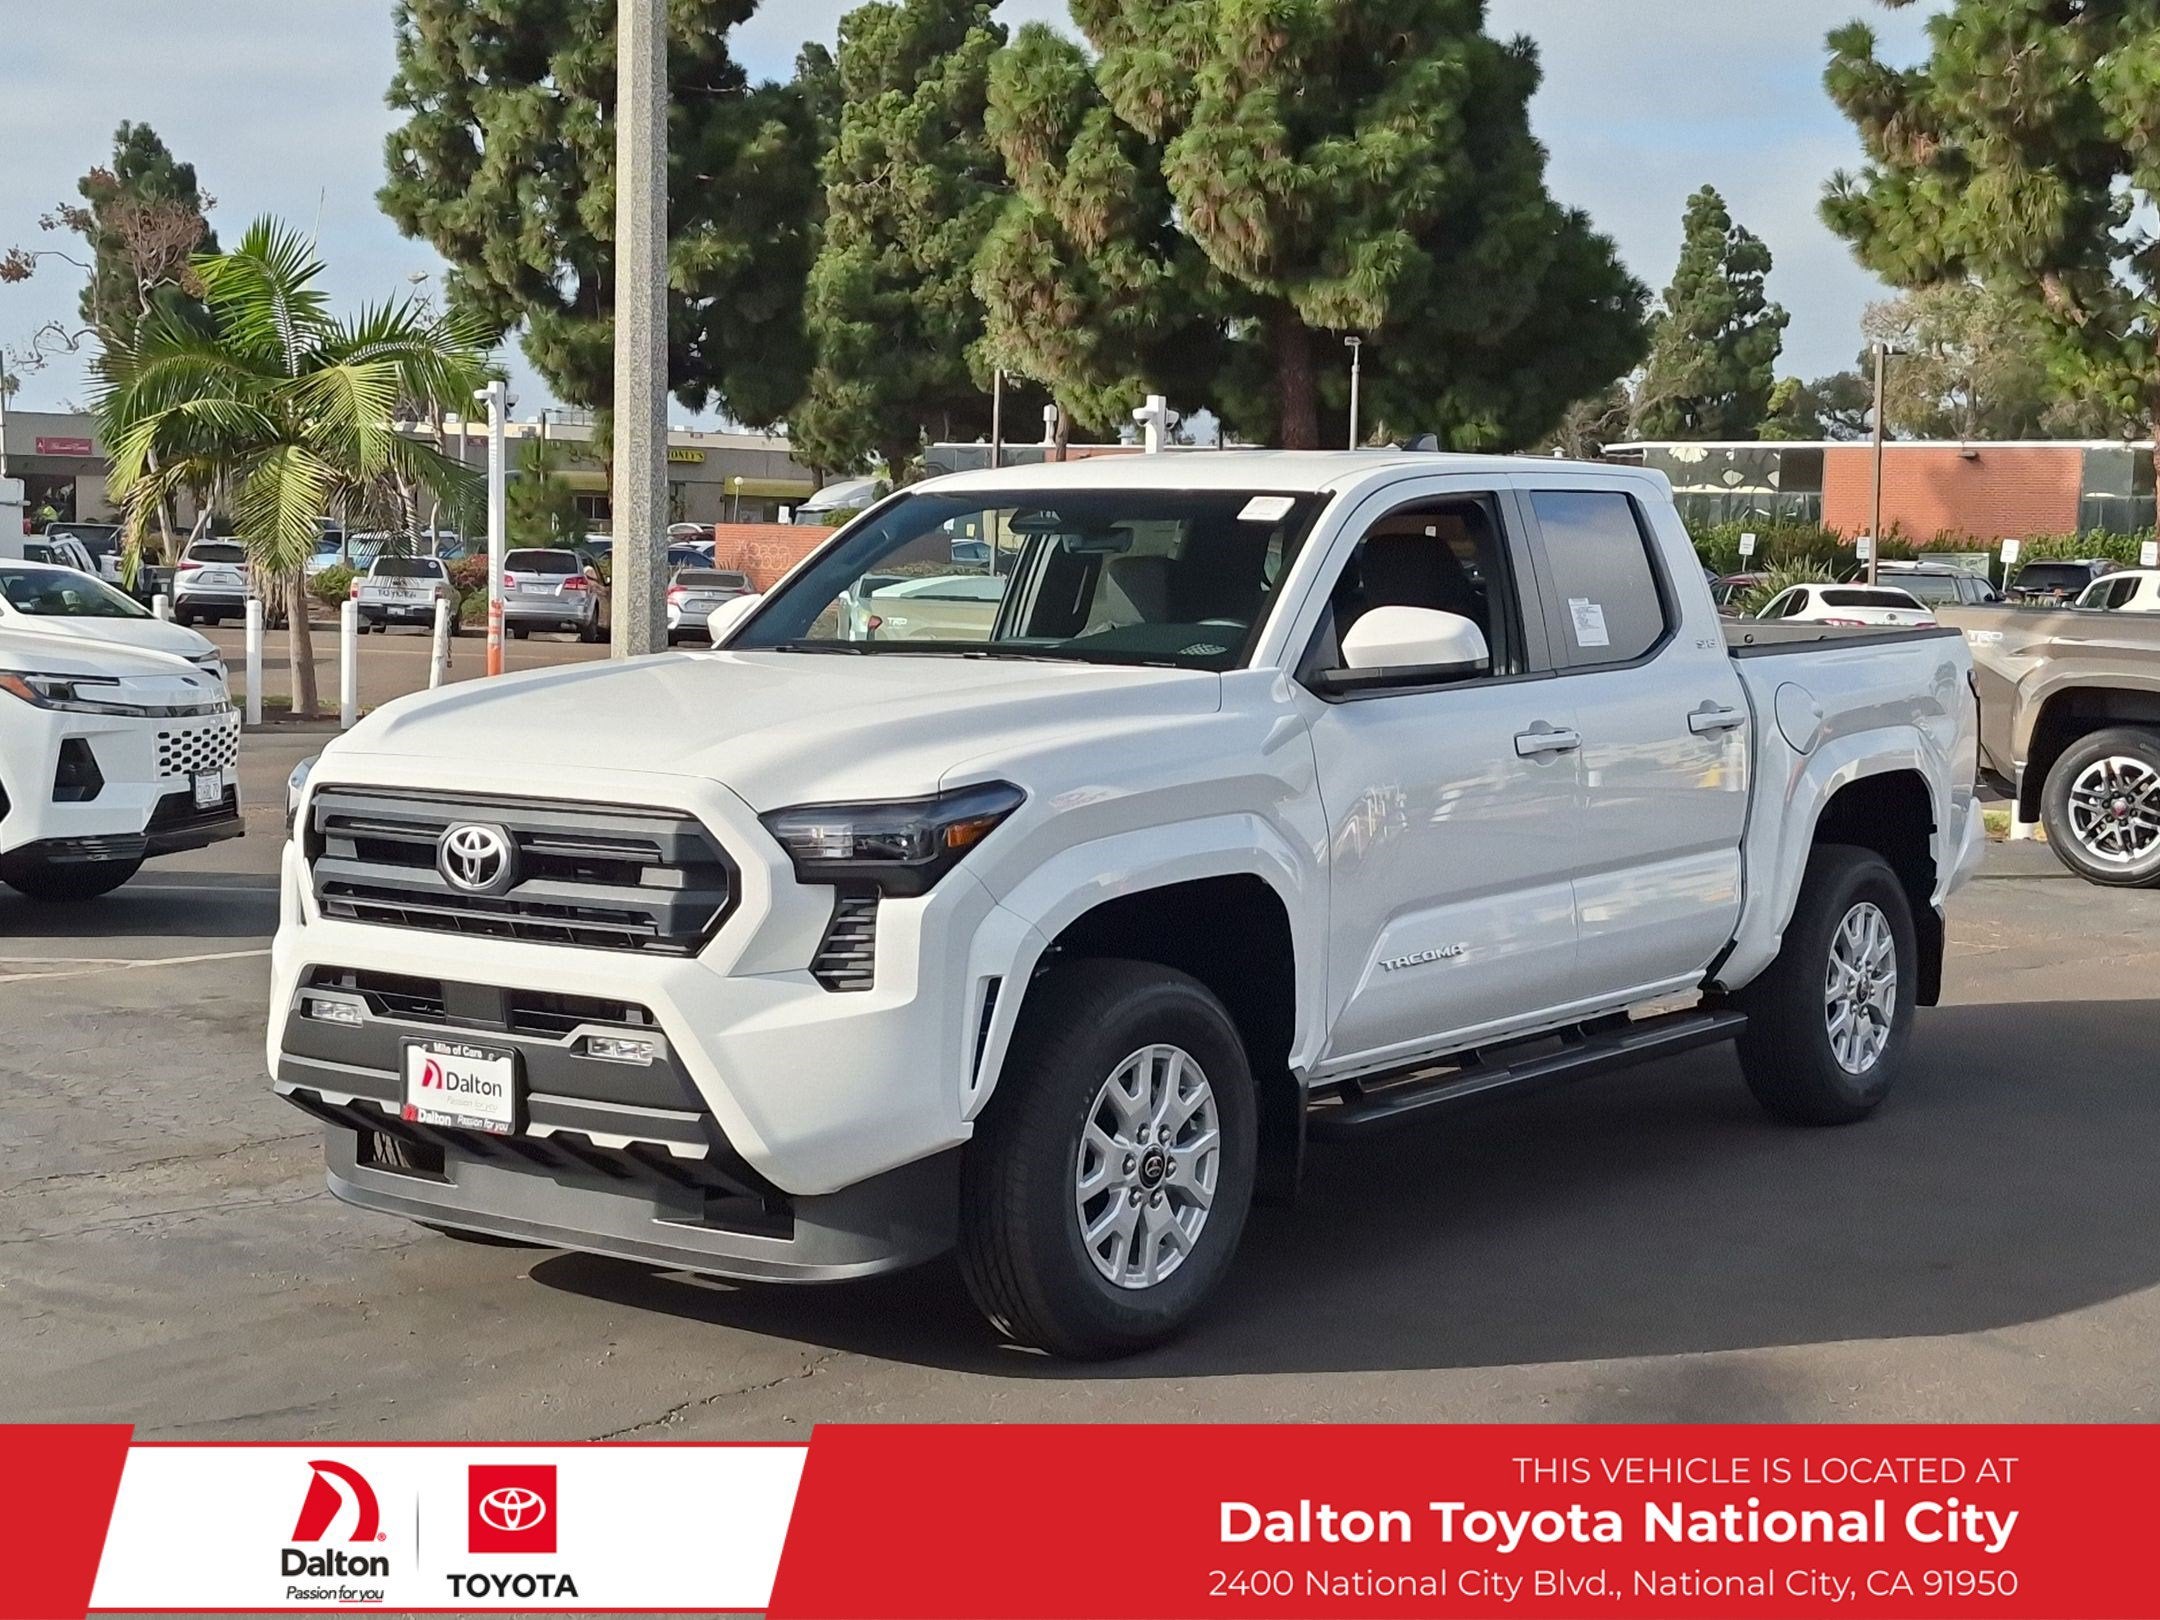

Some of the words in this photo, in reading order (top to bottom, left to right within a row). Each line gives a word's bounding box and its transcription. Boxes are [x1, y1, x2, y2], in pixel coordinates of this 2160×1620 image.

[1967, 629, 2003, 642] TRD
[1379, 944, 1465, 972] TACOMA
[453, 1045, 462, 1055] of
[463, 1047, 483, 1058] Cars
[446, 1071, 502, 1097] Dalton
[418, 1108, 452, 1126] Dalton
[457, 1114, 484, 1127] Passion
[484, 1116, 494, 1129] for
[494, 1121, 509, 1132] you
